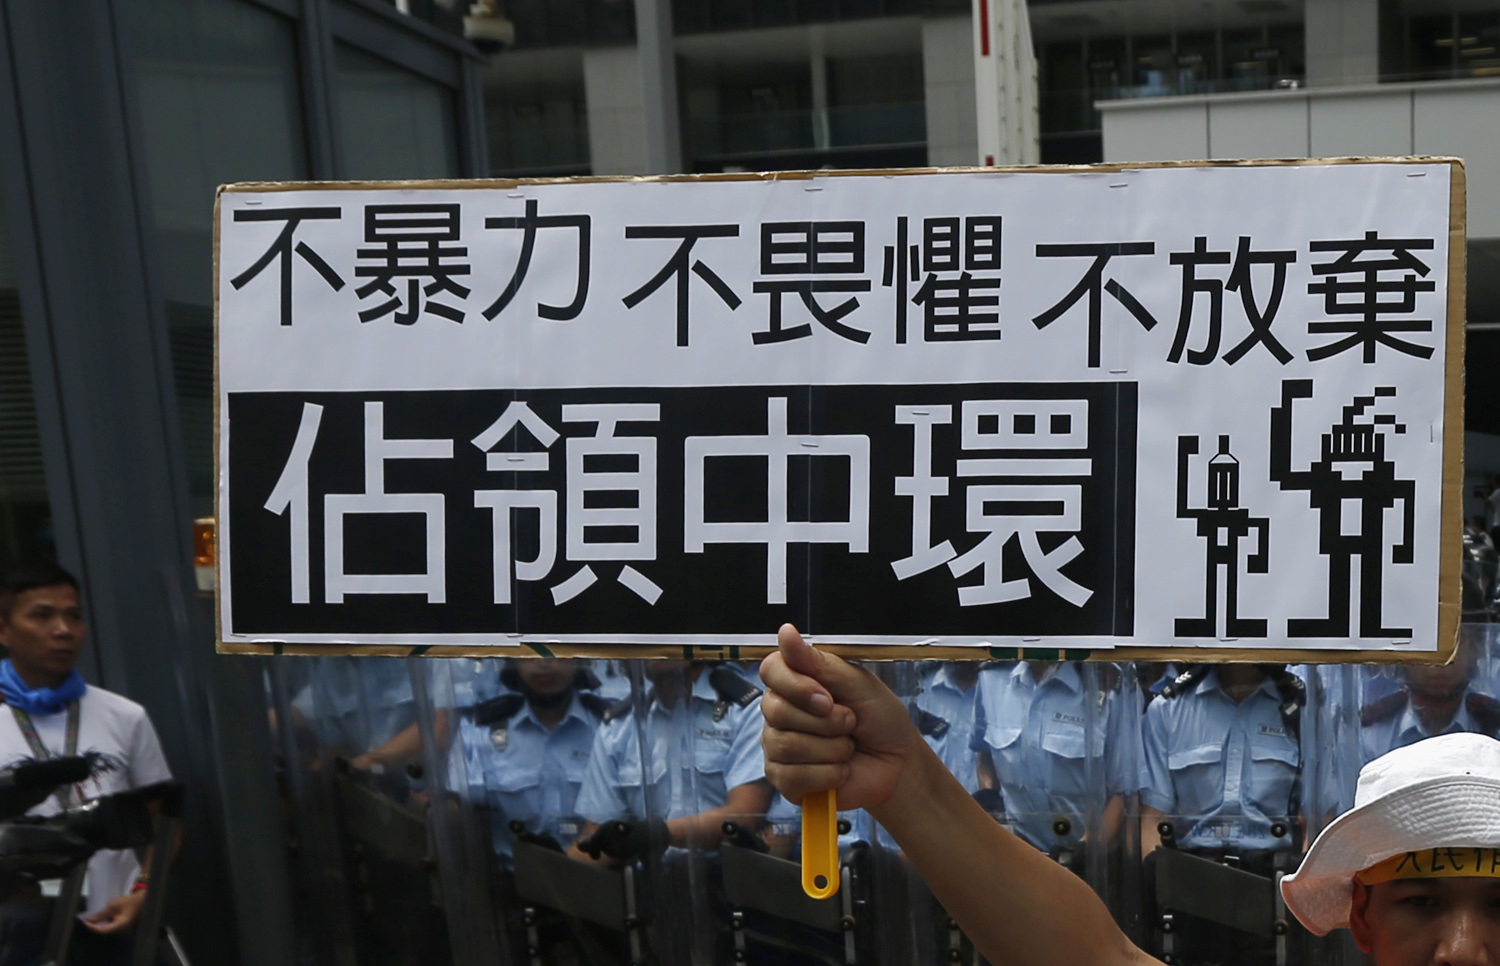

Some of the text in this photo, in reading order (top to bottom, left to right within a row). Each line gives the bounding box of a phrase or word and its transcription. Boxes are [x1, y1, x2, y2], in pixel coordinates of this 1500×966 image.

[230, 198, 1436, 369] 不暴力 不畏懼 不放棄
[263, 396, 1094, 608] 佔領中環
